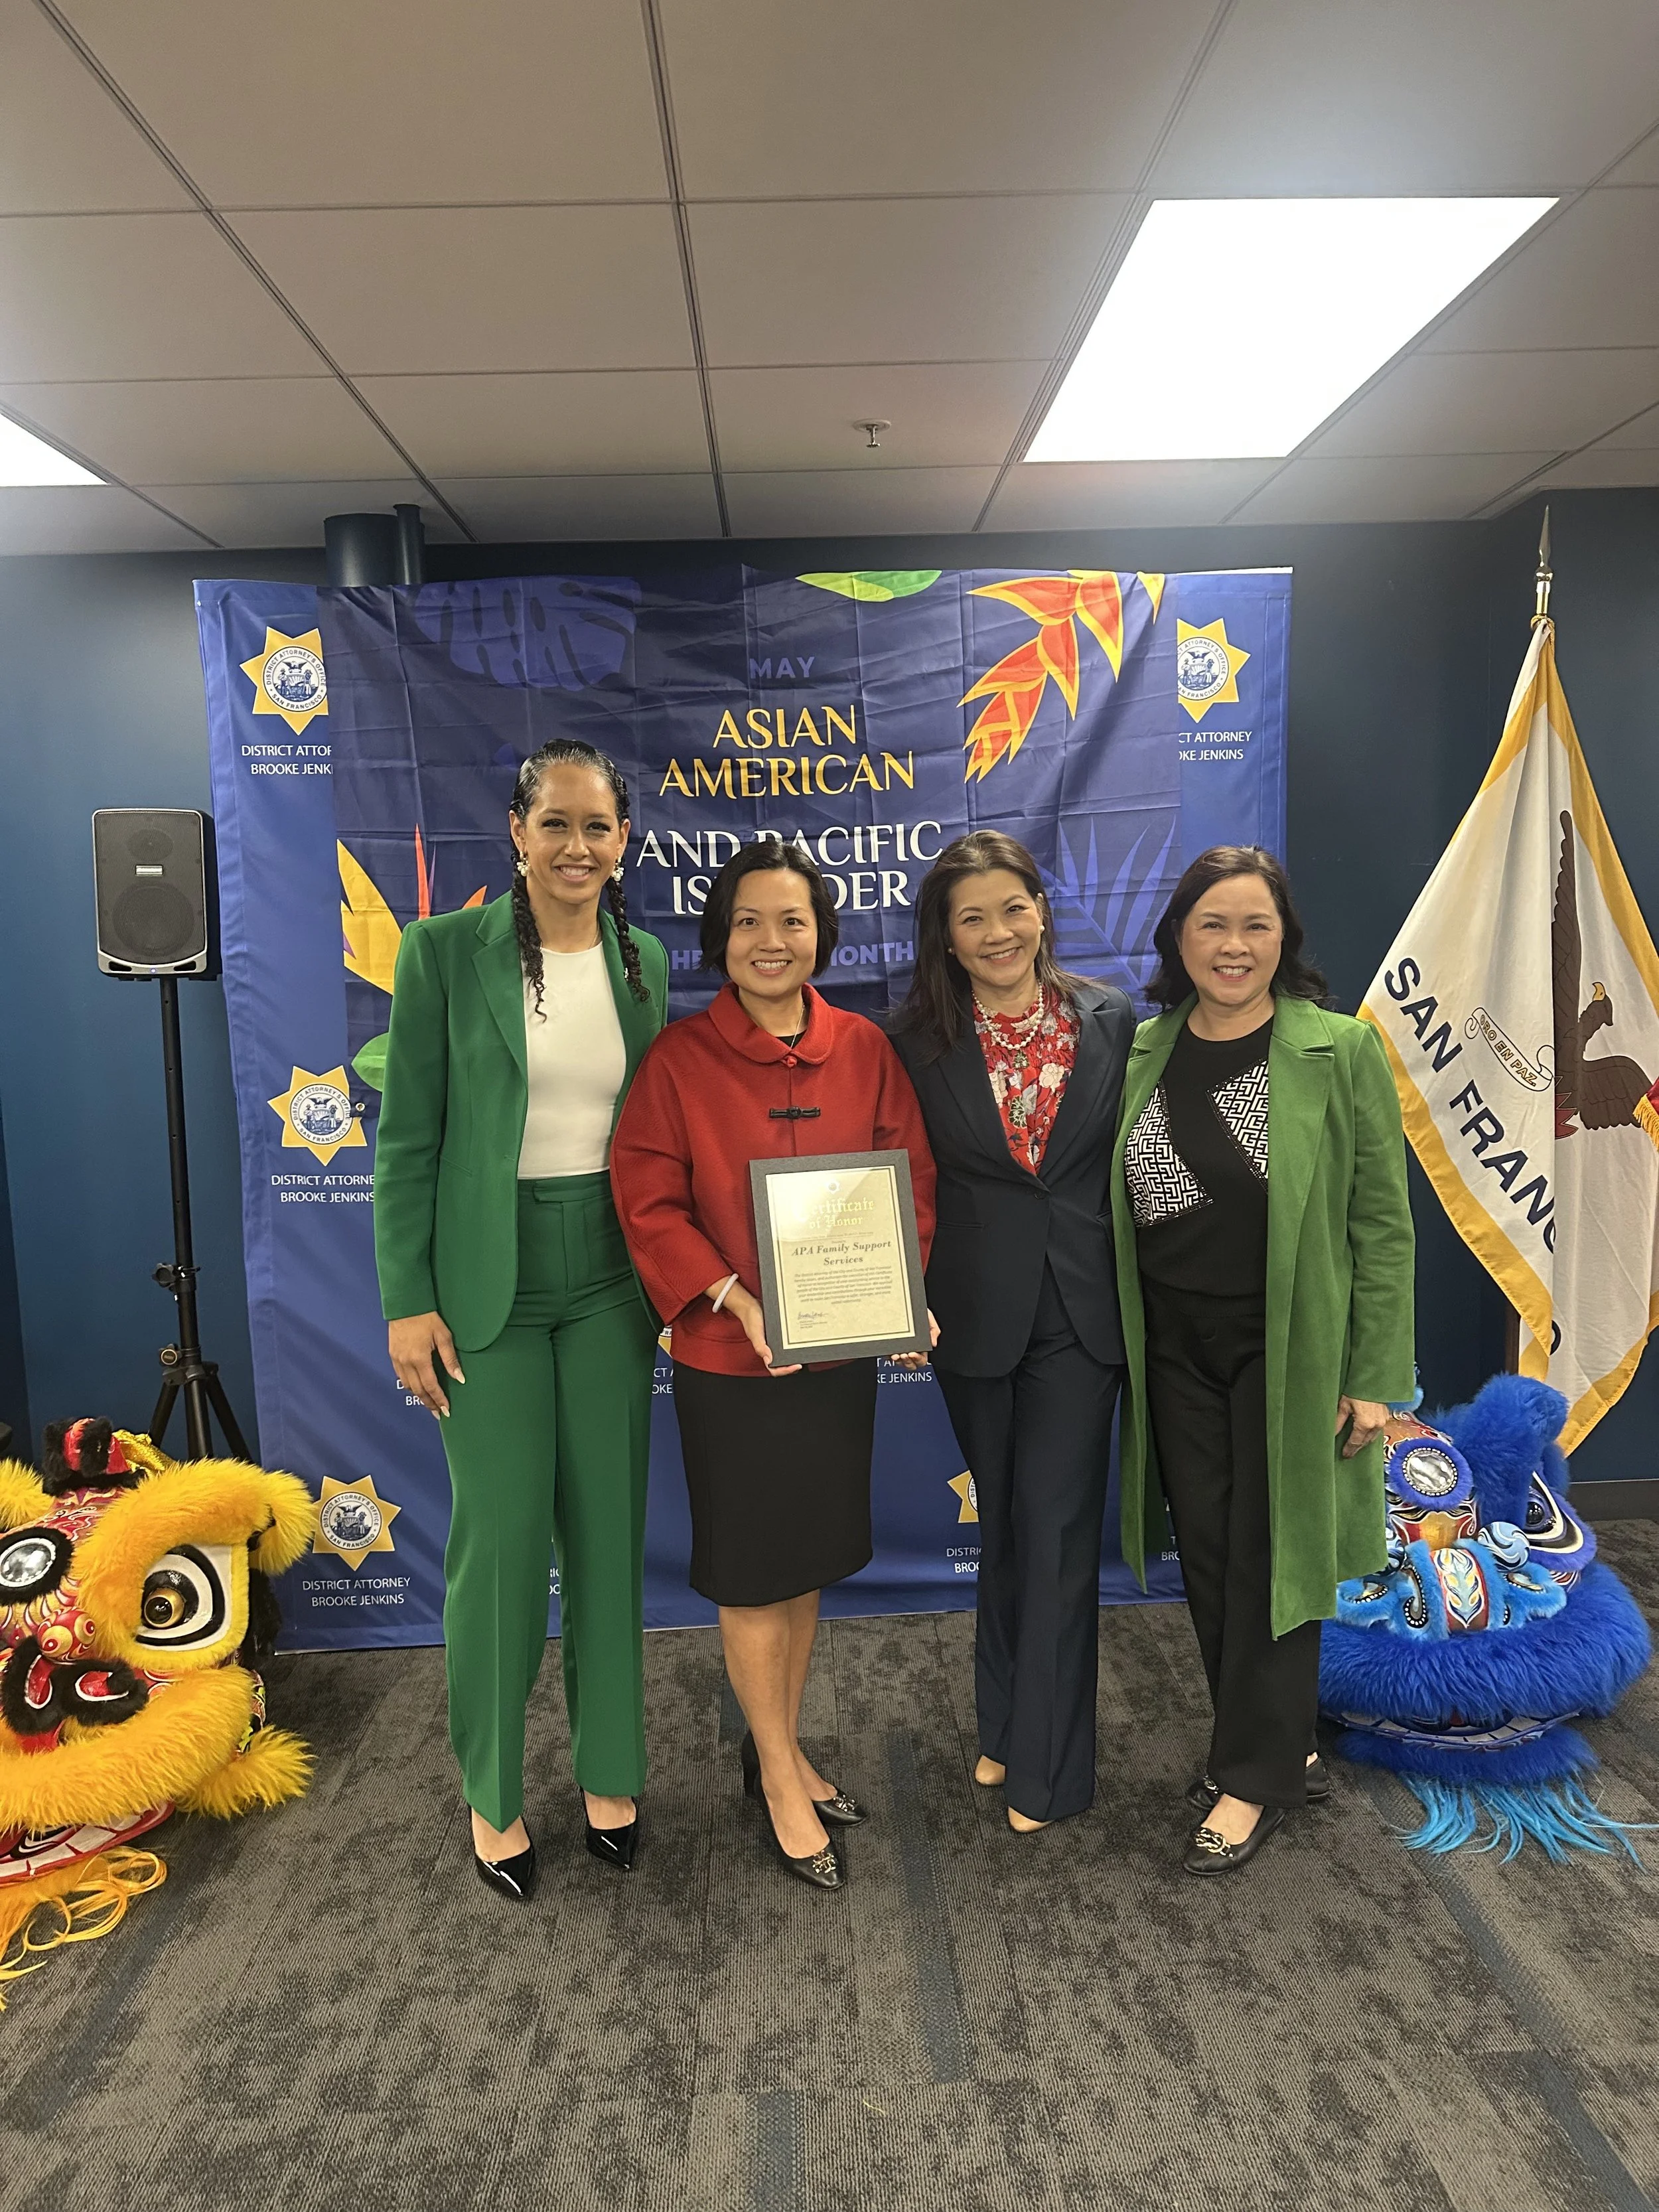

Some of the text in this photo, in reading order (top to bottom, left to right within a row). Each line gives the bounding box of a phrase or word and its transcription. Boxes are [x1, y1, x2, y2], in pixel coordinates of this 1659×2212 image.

[266, 656, 279, 686] DISTRICT
[279, 649, 317, 664] ATTORNEY'S
[749, 656, 816, 679] MAY
[1187, 682, 1221, 698] FRANCISCO
[271, 694, 323, 709] SAN FRANCISCO
[712, 704, 857, 749] ASIAN
[1194, 731, 1252, 743] ATTORNEY
[241, 745, 294, 757] DISTRICT
[1198, 749, 1244, 761] JENKINS
[251, 763, 299, 775] BROOKE
[659, 751, 915, 800] AMERICAN
[636, 828, 742, 869] AND
[1384, 957, 1463, 1074] SAN
[1480, 1014, 1538, 1087] ORO EN PAZ.
[293, 1093, 305, 1121] DISTRICT
[299, 1128, 348, 1143] SAN FRANCISCO
[271, 1175, 375, 1186] DISTRICT ATTORNE
[280, 1191, 327, 1203] BROOKE
[812, 1197, 876, 1215] ertificate
[791, 1246, 814, 1256] APA
[817, 1243, 850, 1254] Family
[852, 1240, 892, 1252] Support
[824, 1256, 864, 1266] Services
[888, 1371, 932, 1383] JENKINS
[323, 1494, 380, 1528] DISTRICT ATTORNEY'S OFFICE
[329, 1533, 376, 1548] SAN FRANCISCO
[302, 1577, 411, 1591] DISTRICT ATTORNEY
[311, 1593, 405, 1607] BROOKE JENKINS
